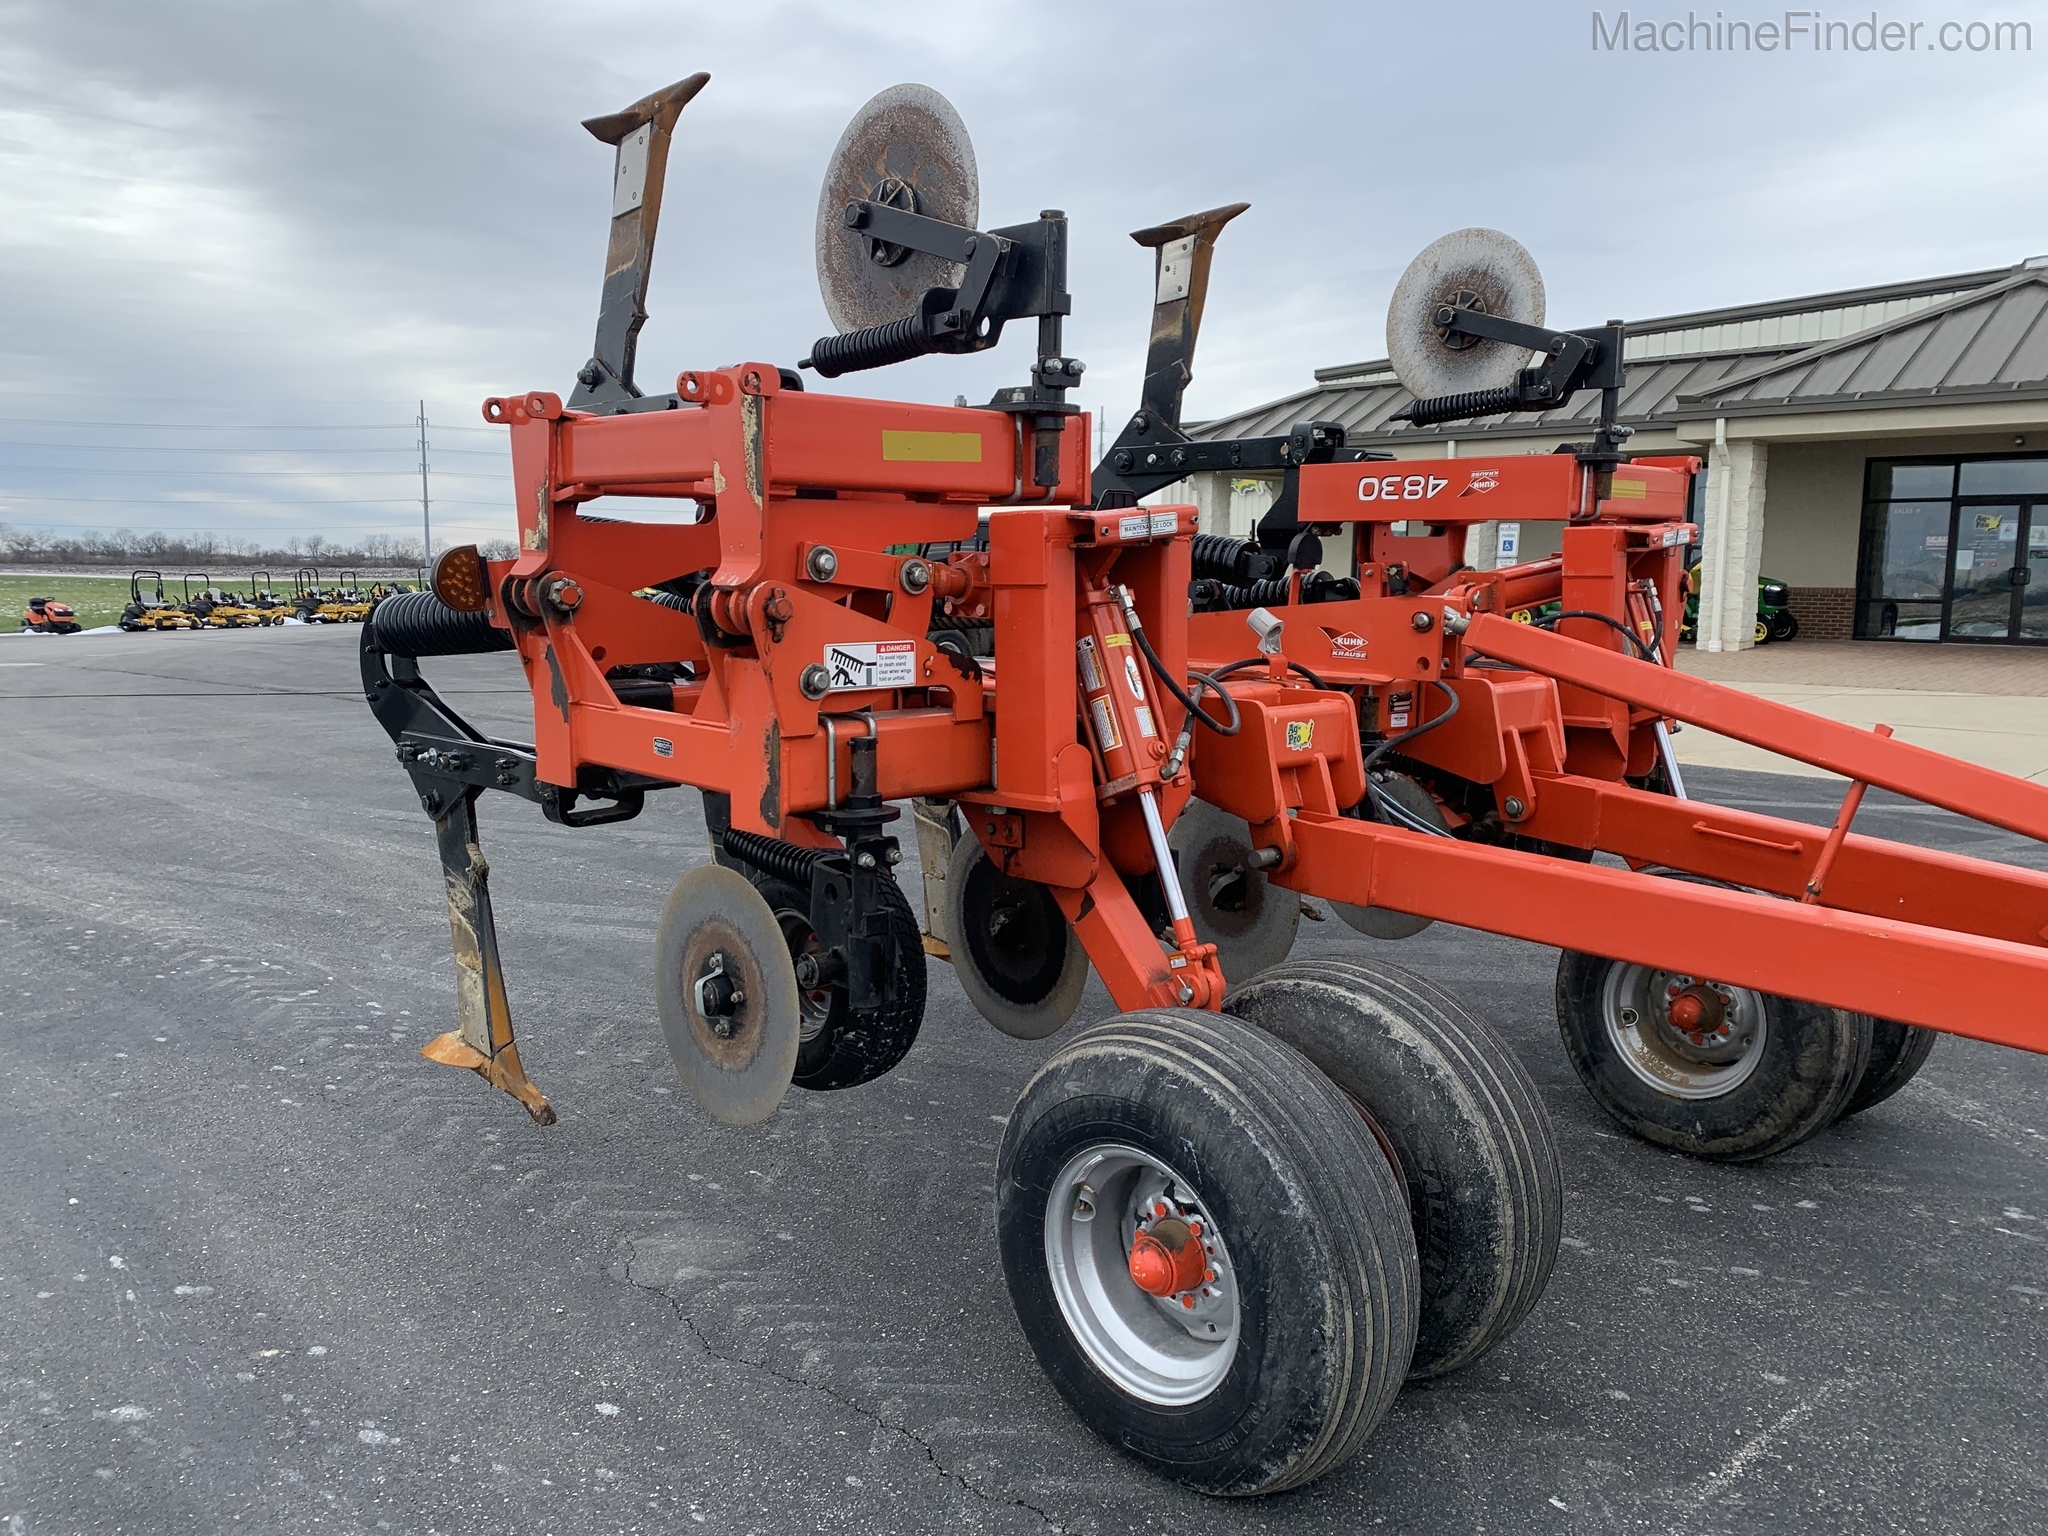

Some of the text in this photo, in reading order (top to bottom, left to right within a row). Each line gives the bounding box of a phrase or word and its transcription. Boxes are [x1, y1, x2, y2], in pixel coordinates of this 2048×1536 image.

[1357, 474, 1449, 502] 4830
[1473, 481, 1495, 489] KUHN
[1160, 520, 1174, 528] LOCK
[1337, 636, 1363, 646] KUHN
[886, 644, 911, 652] DANGER
[1332, 650, 1367, 659] KRAUSE
[1288, 735, 1301, 745] Pro
